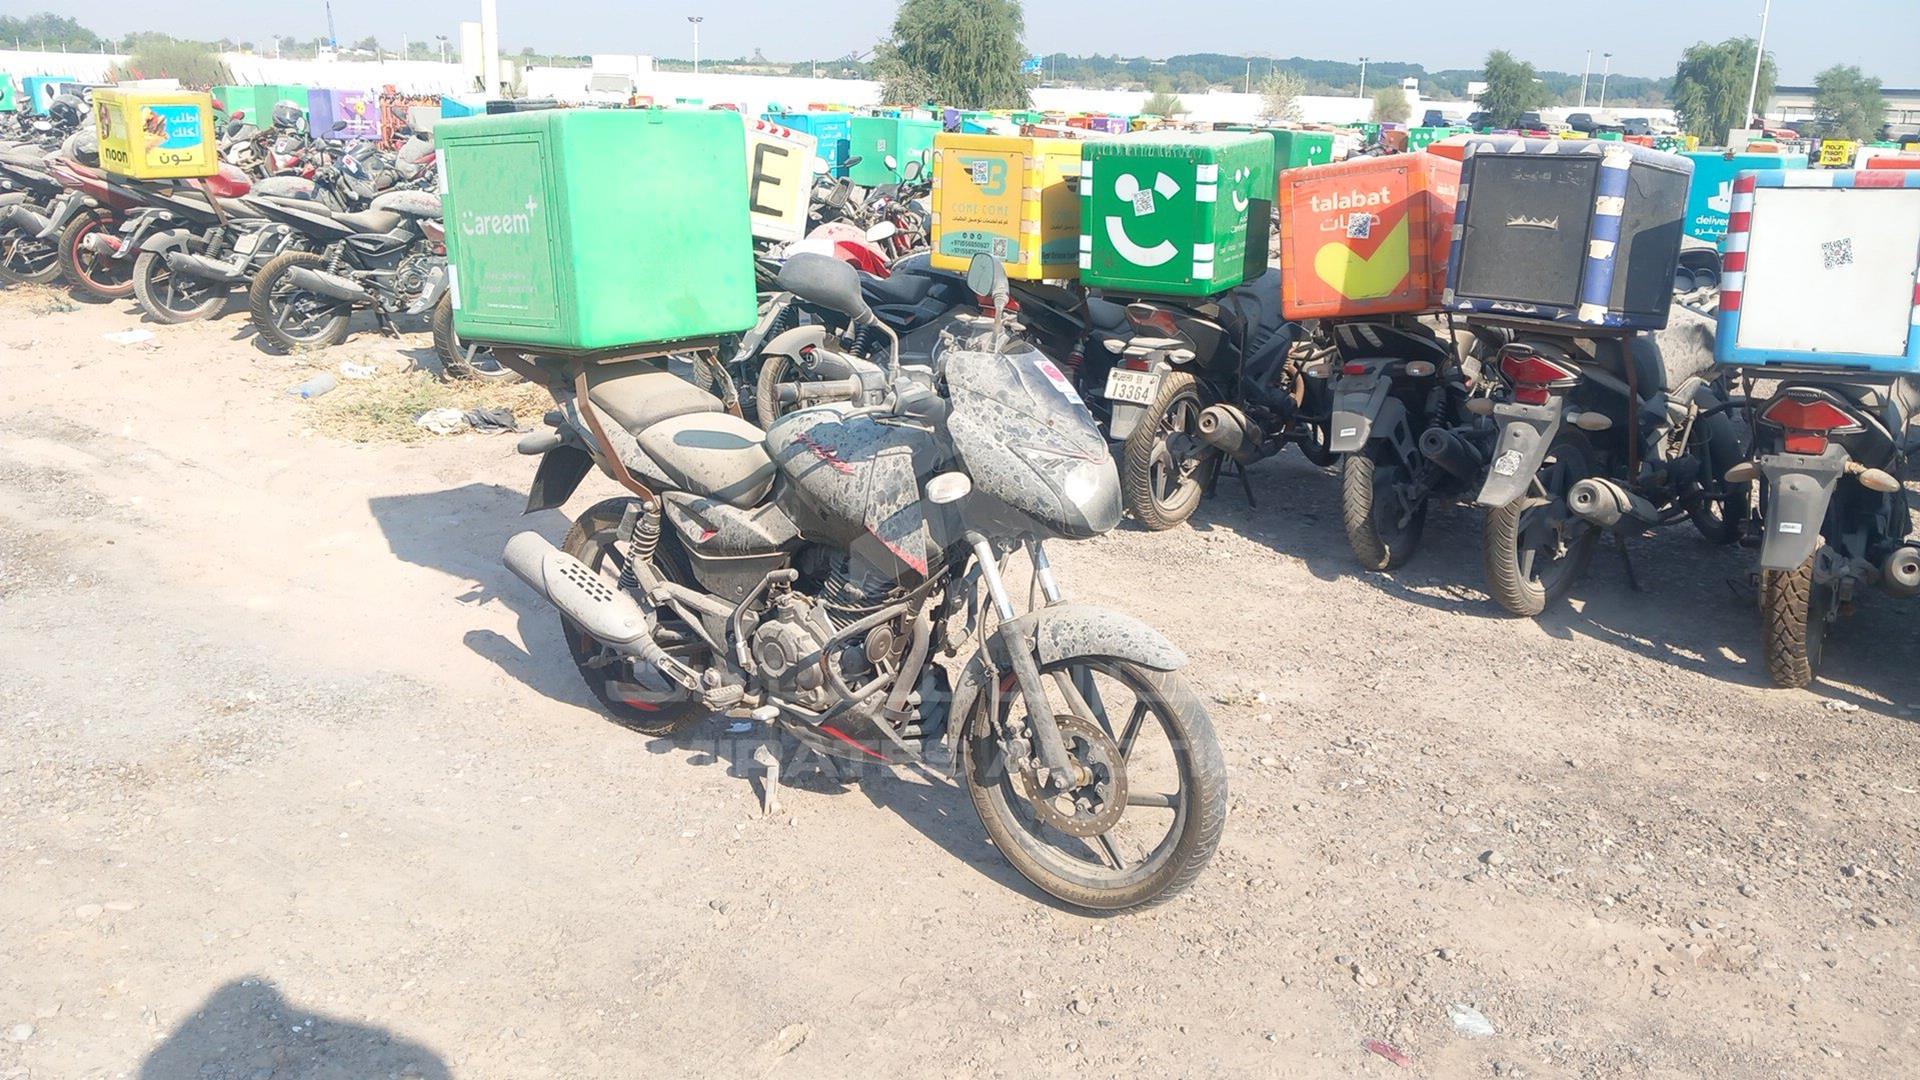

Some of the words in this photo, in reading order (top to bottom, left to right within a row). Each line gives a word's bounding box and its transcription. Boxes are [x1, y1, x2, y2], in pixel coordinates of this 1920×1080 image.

[105, 148, 129, 163] noon
[159, 152, 193, 165] نون
[750, 143, 789, 217] E
[1309, 186, 1392, 213] talabat
[1112, 383, 1150, 401] 13364
